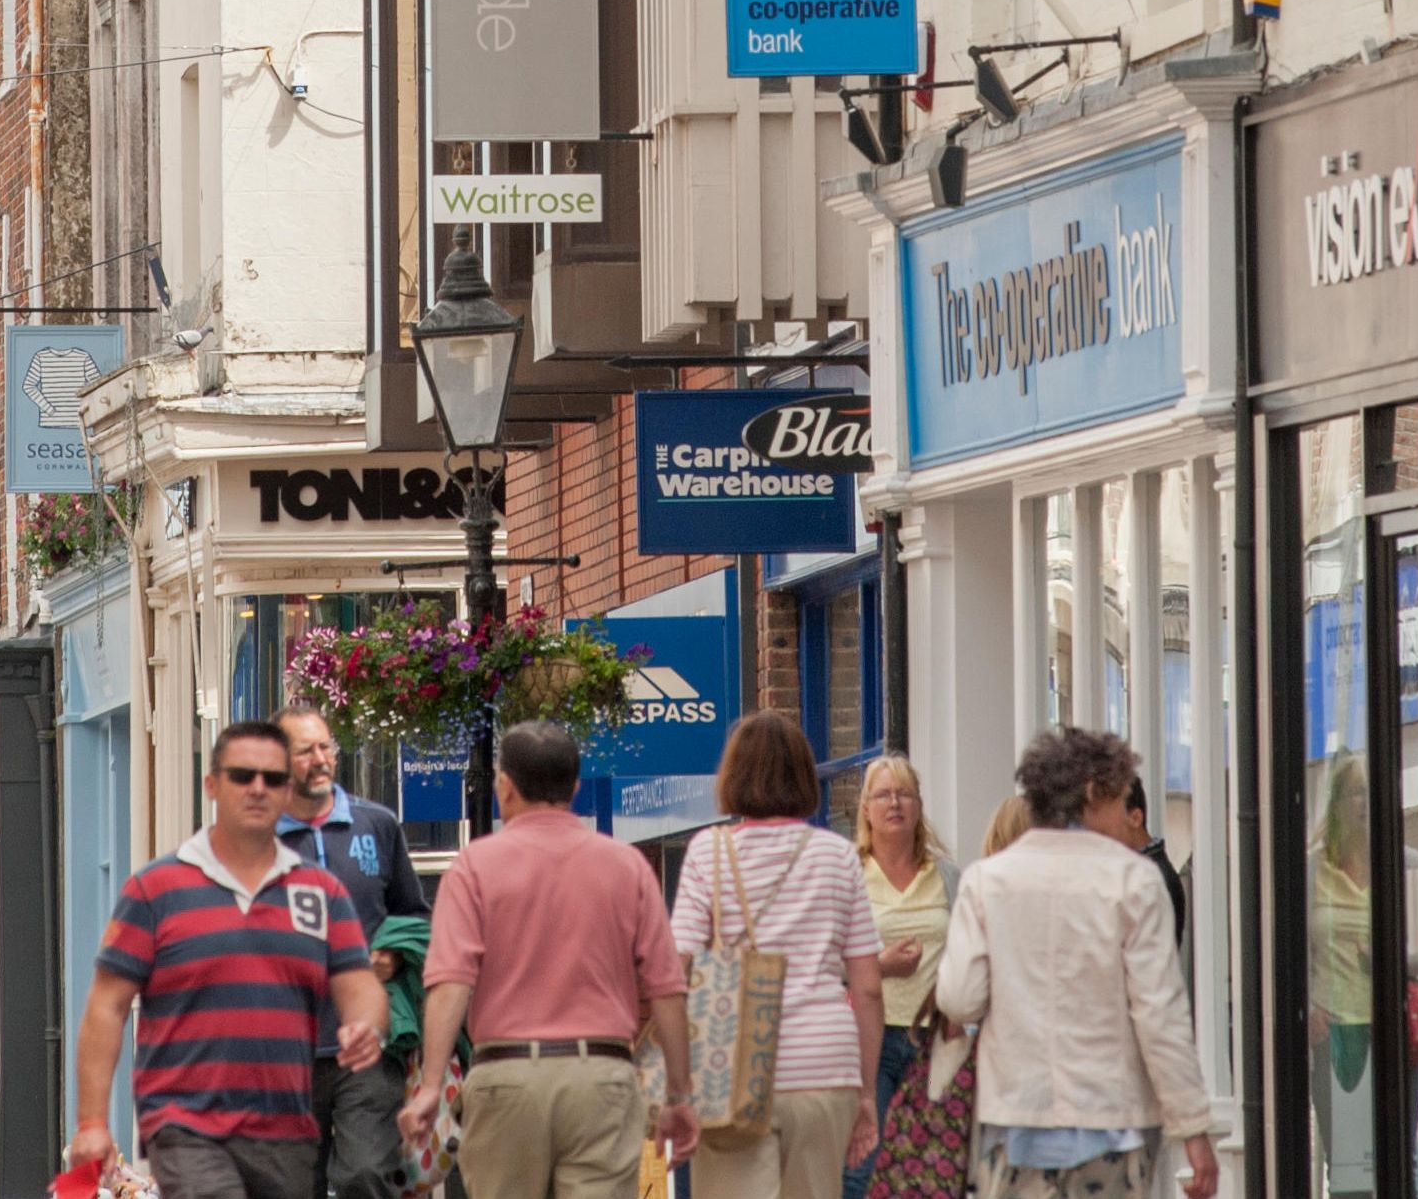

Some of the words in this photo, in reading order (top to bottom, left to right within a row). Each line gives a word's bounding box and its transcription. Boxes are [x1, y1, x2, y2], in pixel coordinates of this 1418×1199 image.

[748, 28, 804, 54] bank
[440, 184, 595, 215] Waitrose
[1304, 152, 1387, 288] vision
[932, 262, 971, 388] The
[971, 219, 1111, 396] co-operative
[1115, 192, 1177, 340] bank
[656, 444, 668, 470] THE
[672, 445, 771, 472] Carp
[657, 471, 834, 498] Warehouse
[349, 834, 377, 860] 49
[293, 890, 324, 932] 9
